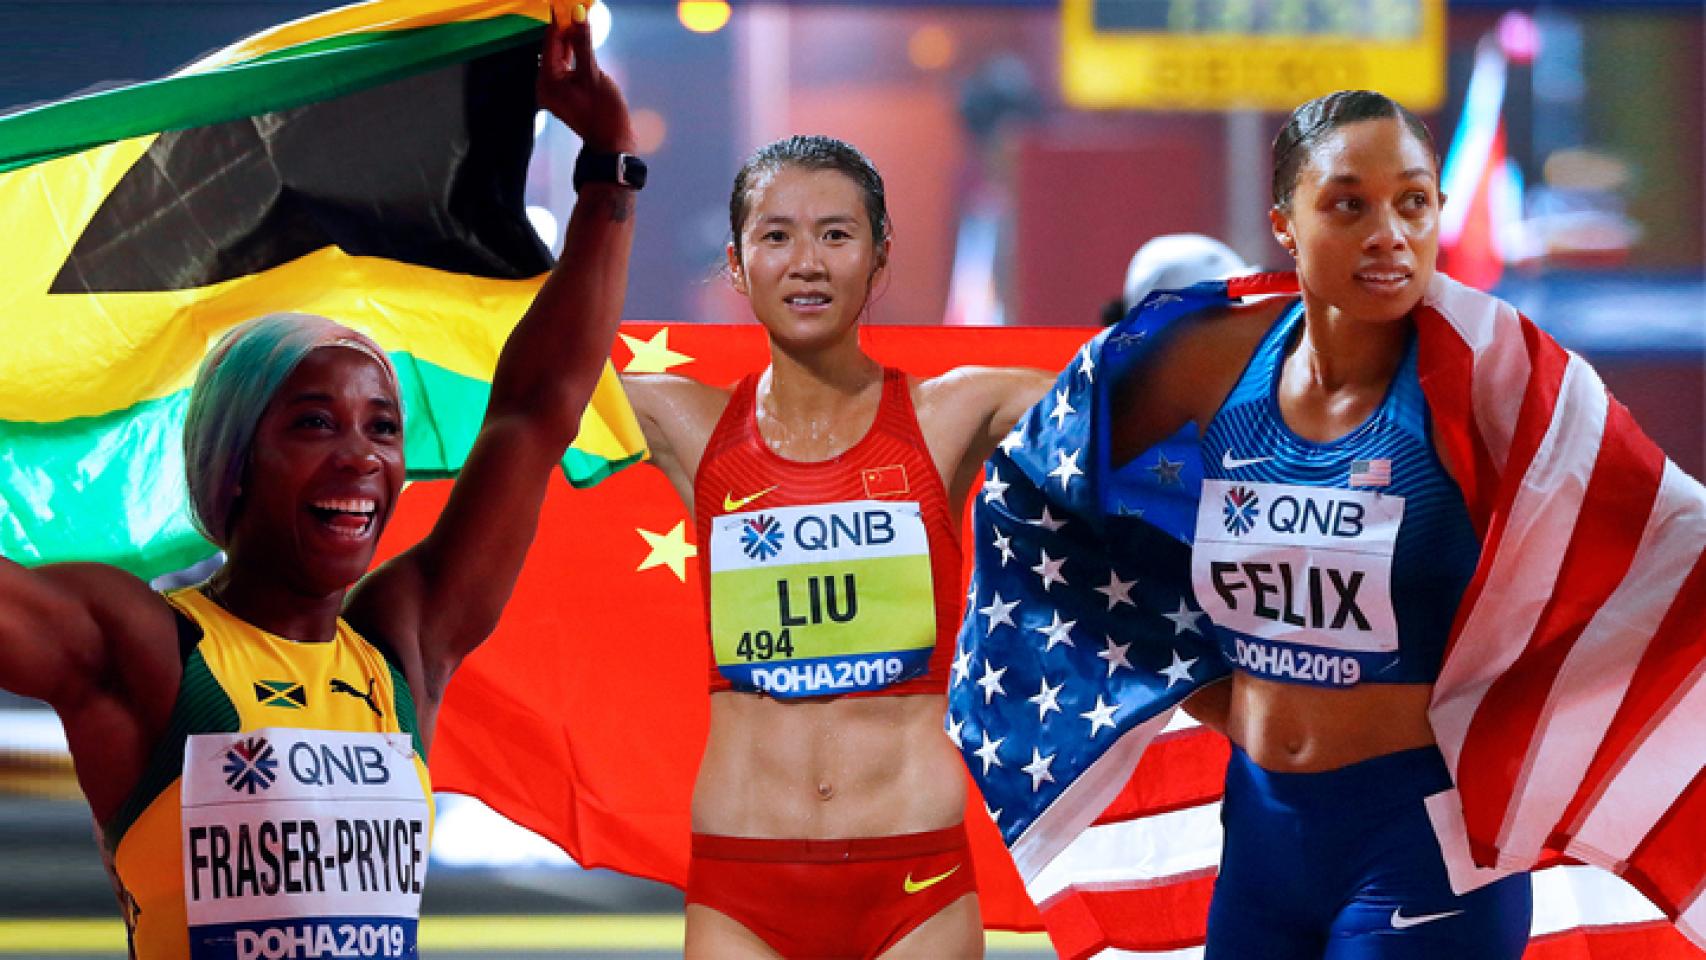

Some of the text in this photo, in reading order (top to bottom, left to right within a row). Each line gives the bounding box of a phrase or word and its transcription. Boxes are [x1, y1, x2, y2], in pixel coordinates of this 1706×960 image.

[794, 510, 895, 550] QNB
[1268, 495, 1365, 538] QNB
[777, 573, 858, 626] LIU
[1210, 561, 1372, 631] FELIX
[736, 628, 794, 661] 494
[1234, 637, 1361, 684] DOHA2019
[751, 657, 903, 693] DOHA2019
[288, 741, 390, 786] QNB
[189, 818, 422, 901] FRASER-PRYCE
[235, 923, 404, 960] DOHA2019
